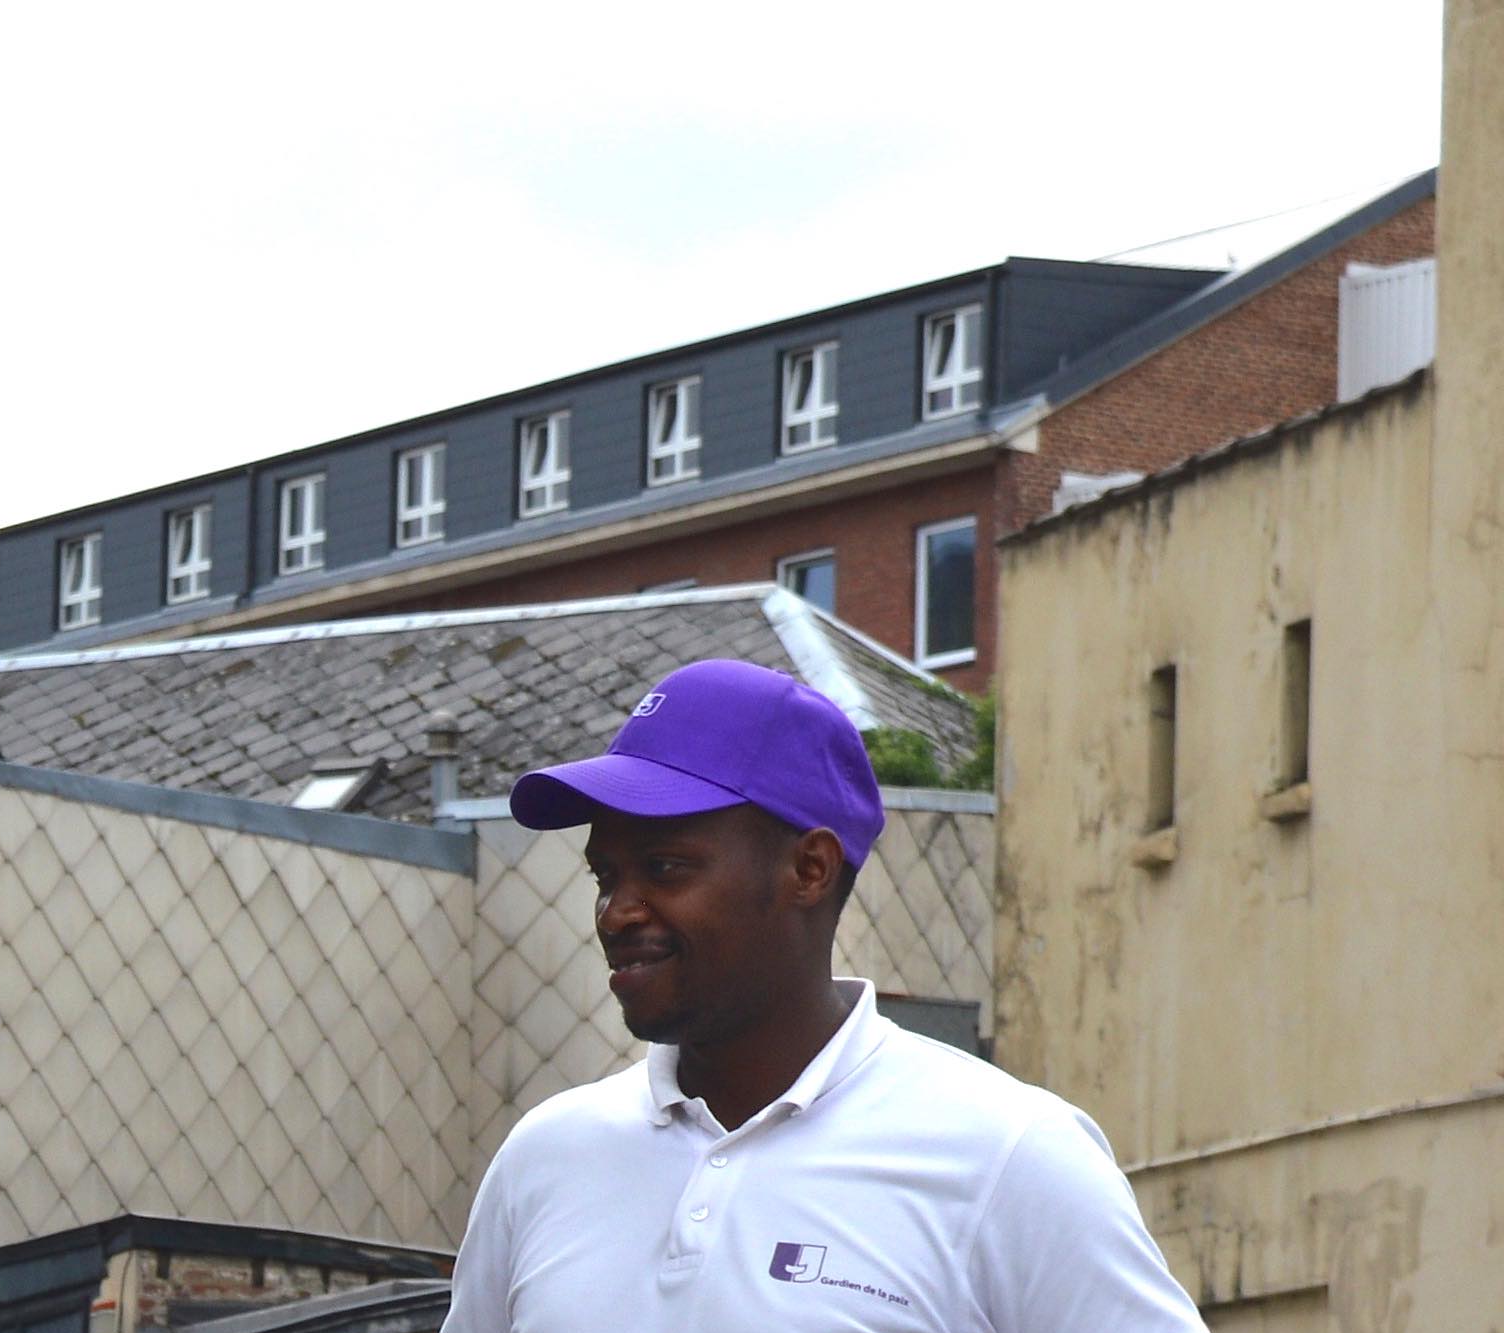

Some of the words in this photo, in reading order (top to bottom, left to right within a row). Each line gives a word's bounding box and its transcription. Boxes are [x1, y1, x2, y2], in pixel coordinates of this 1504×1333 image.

[820, 1276, 862, 1292] Gardien
[863, 1285, 877, 1296] de
[878, 1288, 887, 1299] la
[888, 1293, 910, 1307] paix
